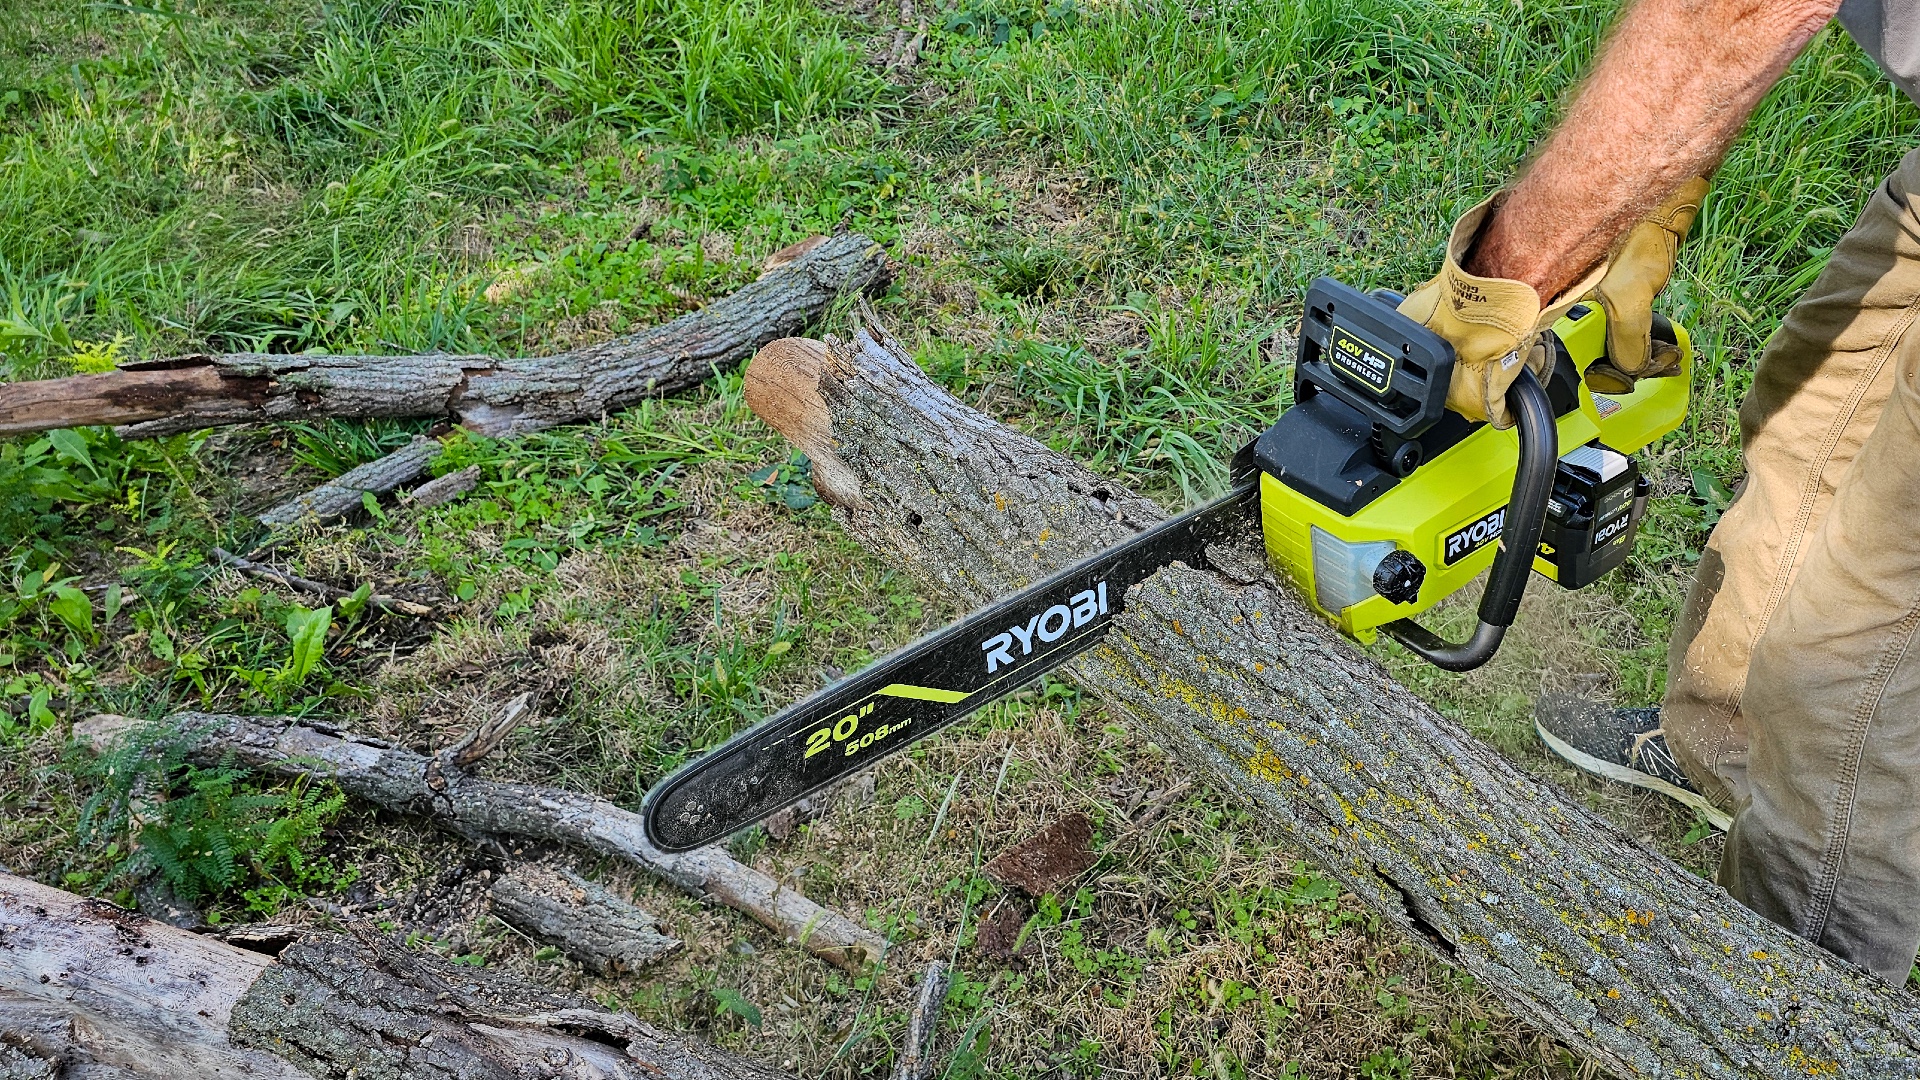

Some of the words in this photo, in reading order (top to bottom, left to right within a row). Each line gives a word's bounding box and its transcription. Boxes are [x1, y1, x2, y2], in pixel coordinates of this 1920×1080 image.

[1447, 271, 1487, 302] VERMO
[1335, 350, 1383, 384] BRUSHLESS
[1337, 338, 1363, 357] 40V
[1362, 351, 1386, 370] HP
[1448, 508, 1506, 558] RYOBI
[1594, 513, 1629, 545] RYOBI
[981, 580, 1108, 674] RYOBI
[804, 701, 875, 759] 20"
[844, 717, 912, 757] 508mm
